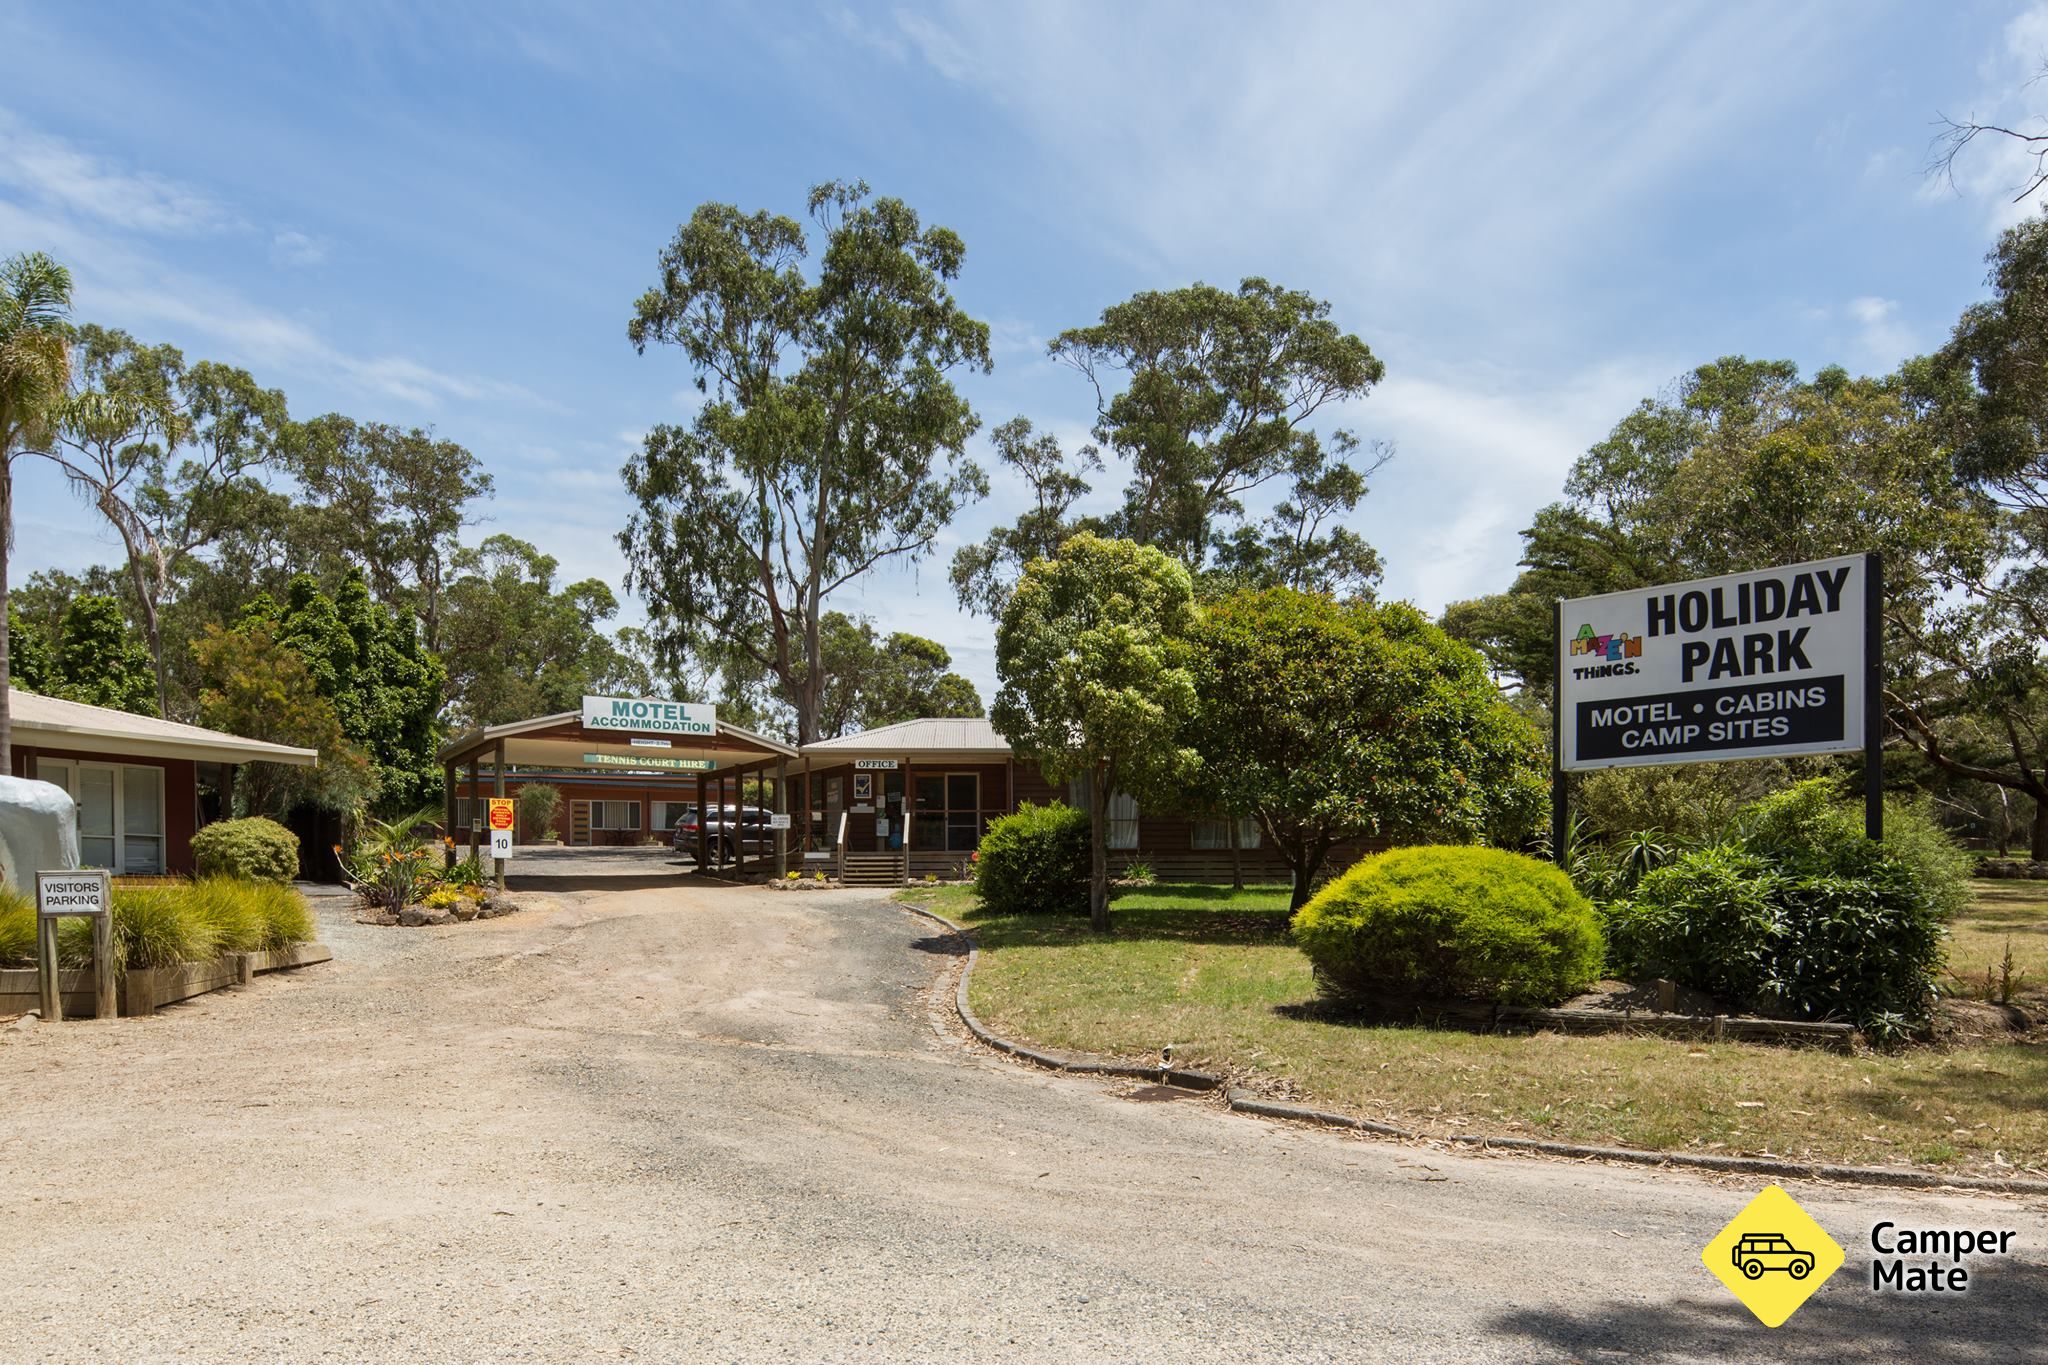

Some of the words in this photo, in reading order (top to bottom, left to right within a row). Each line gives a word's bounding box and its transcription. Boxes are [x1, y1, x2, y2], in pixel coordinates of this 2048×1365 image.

[1647, 567, 1851, 637] HOLIDAY
[1681, 627, 1812, 683] PARK
[612, 701, 692, 721] MOTEL
[1591, 702, 1682, 728] MOTEL
[1715, 687, 1826, 715] CABINS
[590, 716, 711, 732] ACCOMMODATION
[1622, 724, 1700, 749] CAMP
[1708, 717, 1790, 741] SITES
[596, 754, 637, 765] TENNIS
[639, 757, 677, 767] COURT
[679, 760, 706, 769] HIRE
[858, 760, 896, 768] OFFICE
[495, 838, 508, 849] 10
[44, 882, 100, 893] VISITORS
[46, 895, 99, 905] PARKING
